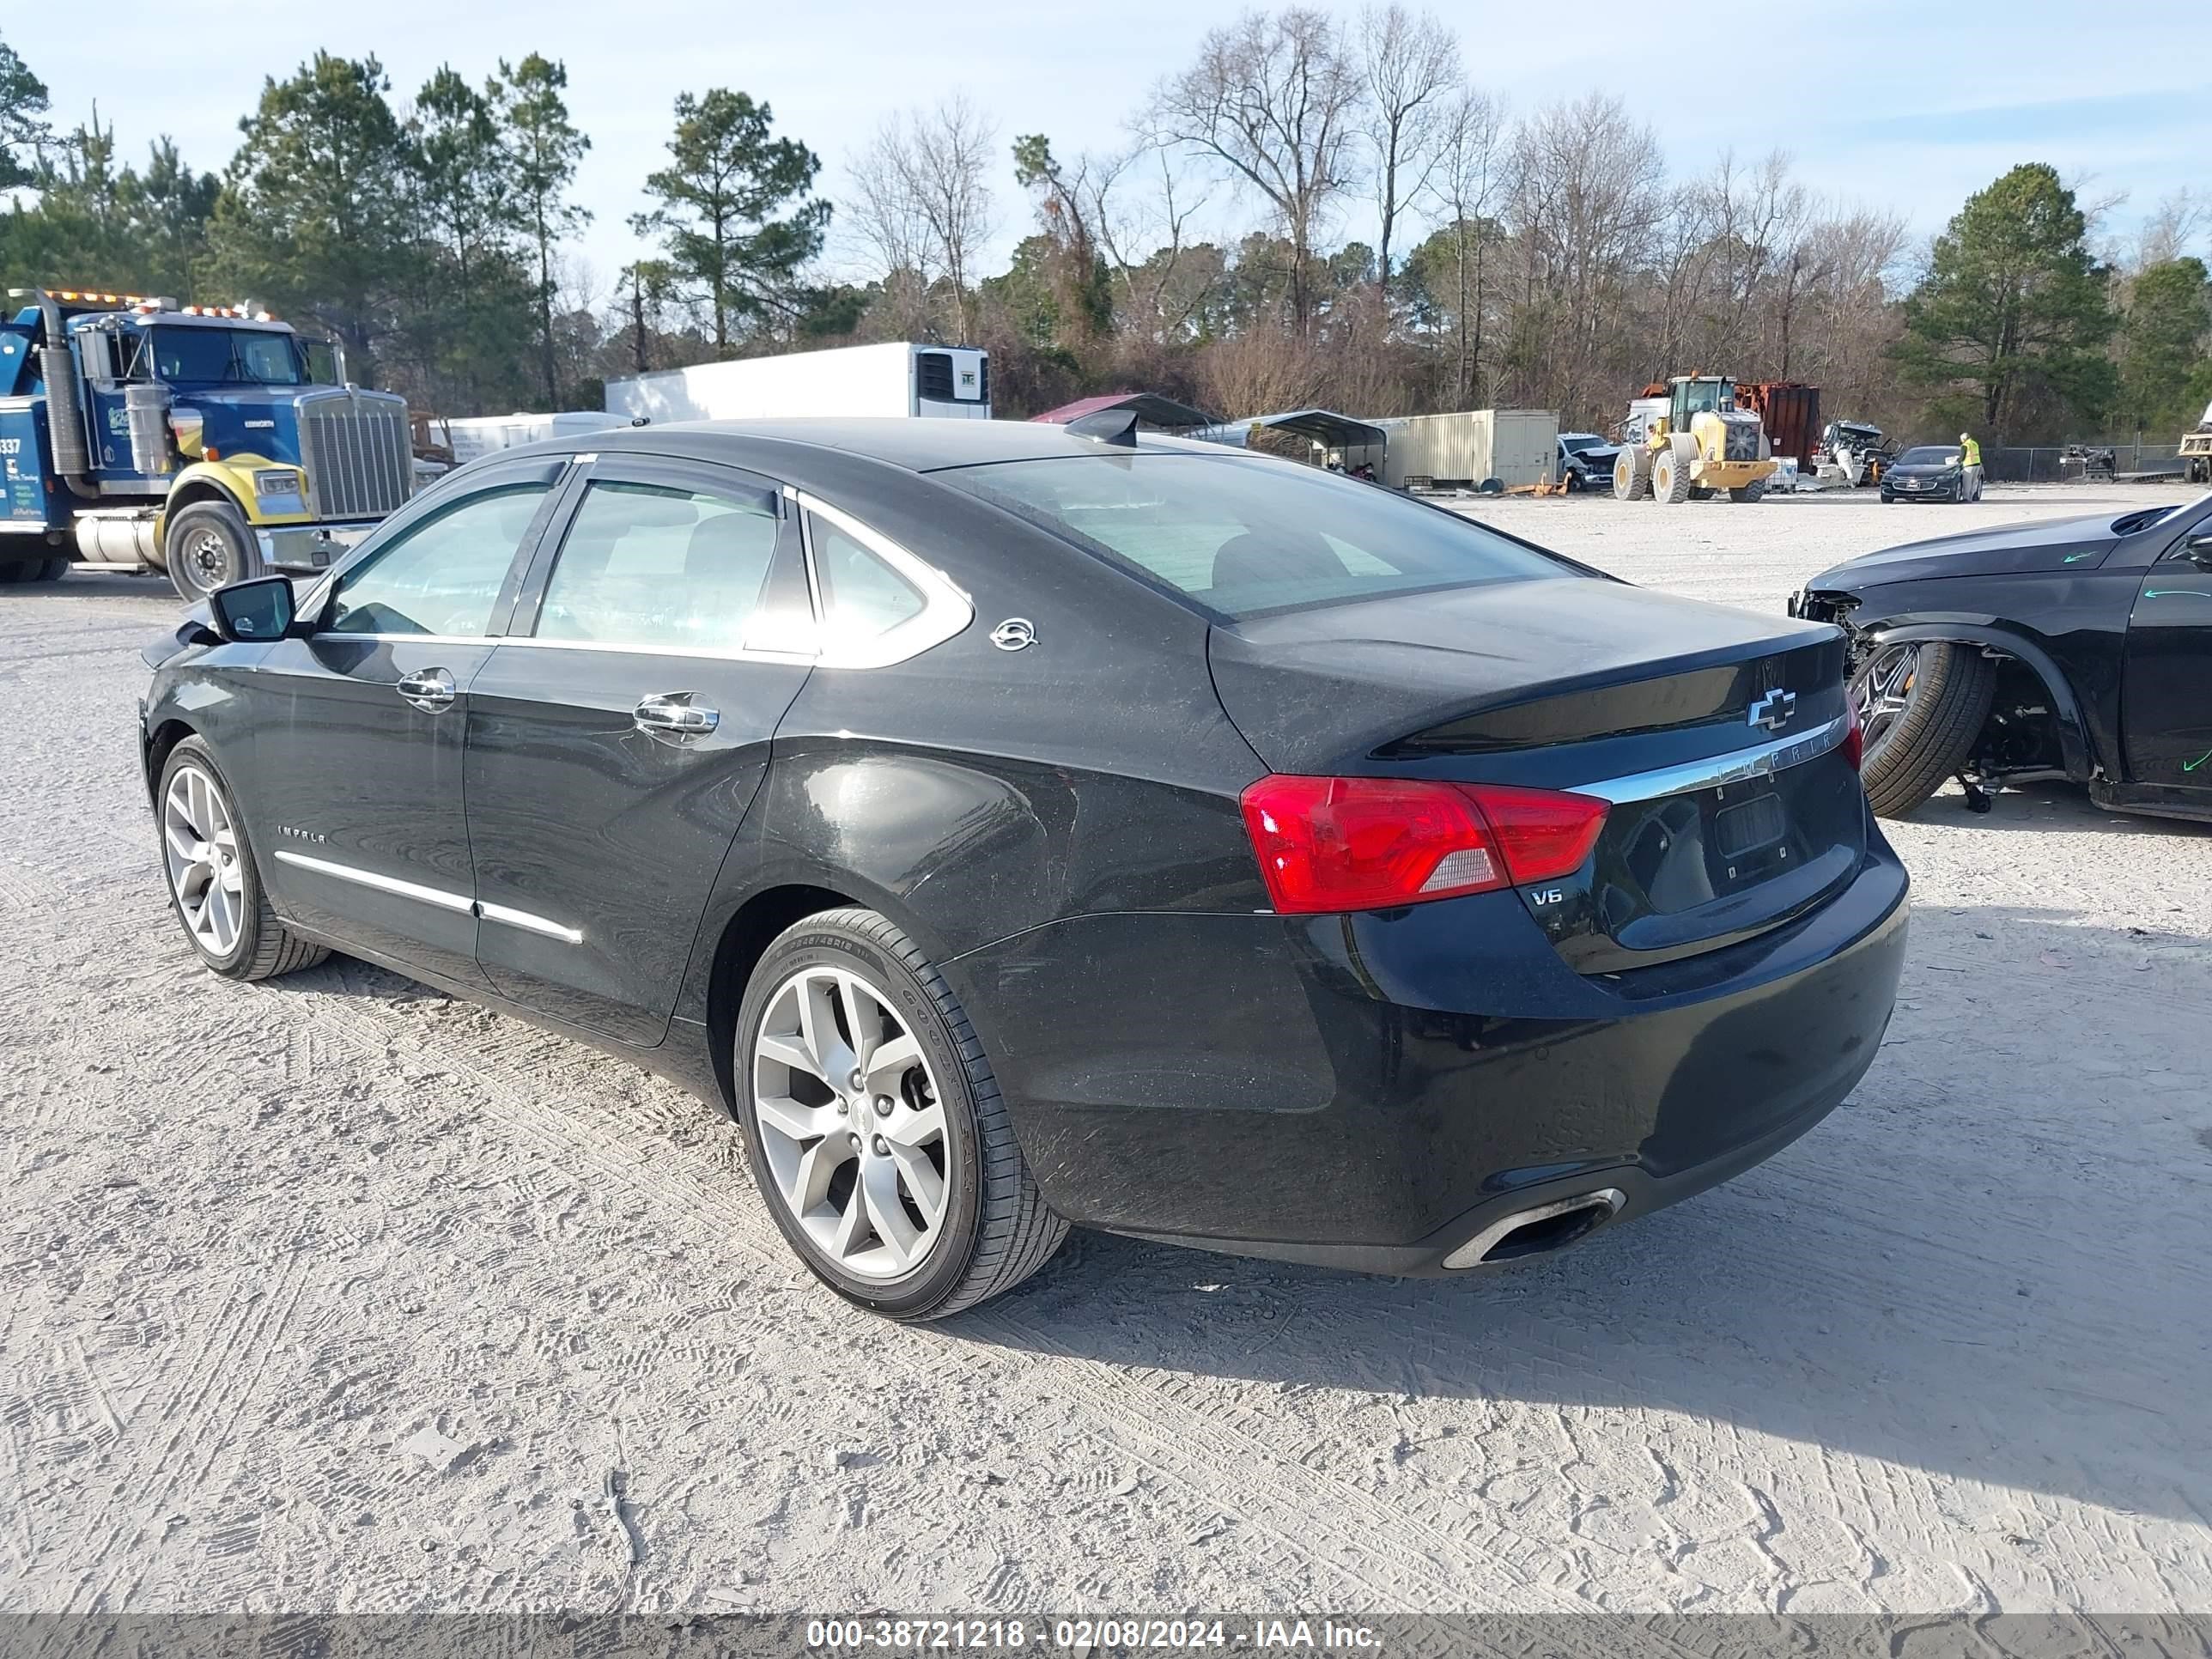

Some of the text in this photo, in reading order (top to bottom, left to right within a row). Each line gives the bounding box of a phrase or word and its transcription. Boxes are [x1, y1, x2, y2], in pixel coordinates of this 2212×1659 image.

[0, 438, 21, 455] 337
[1717, 732, 1832, 780] IMPALA
[277, 824, 325, 845] IMPALA
[1531, 888, 1563, 906] V6
